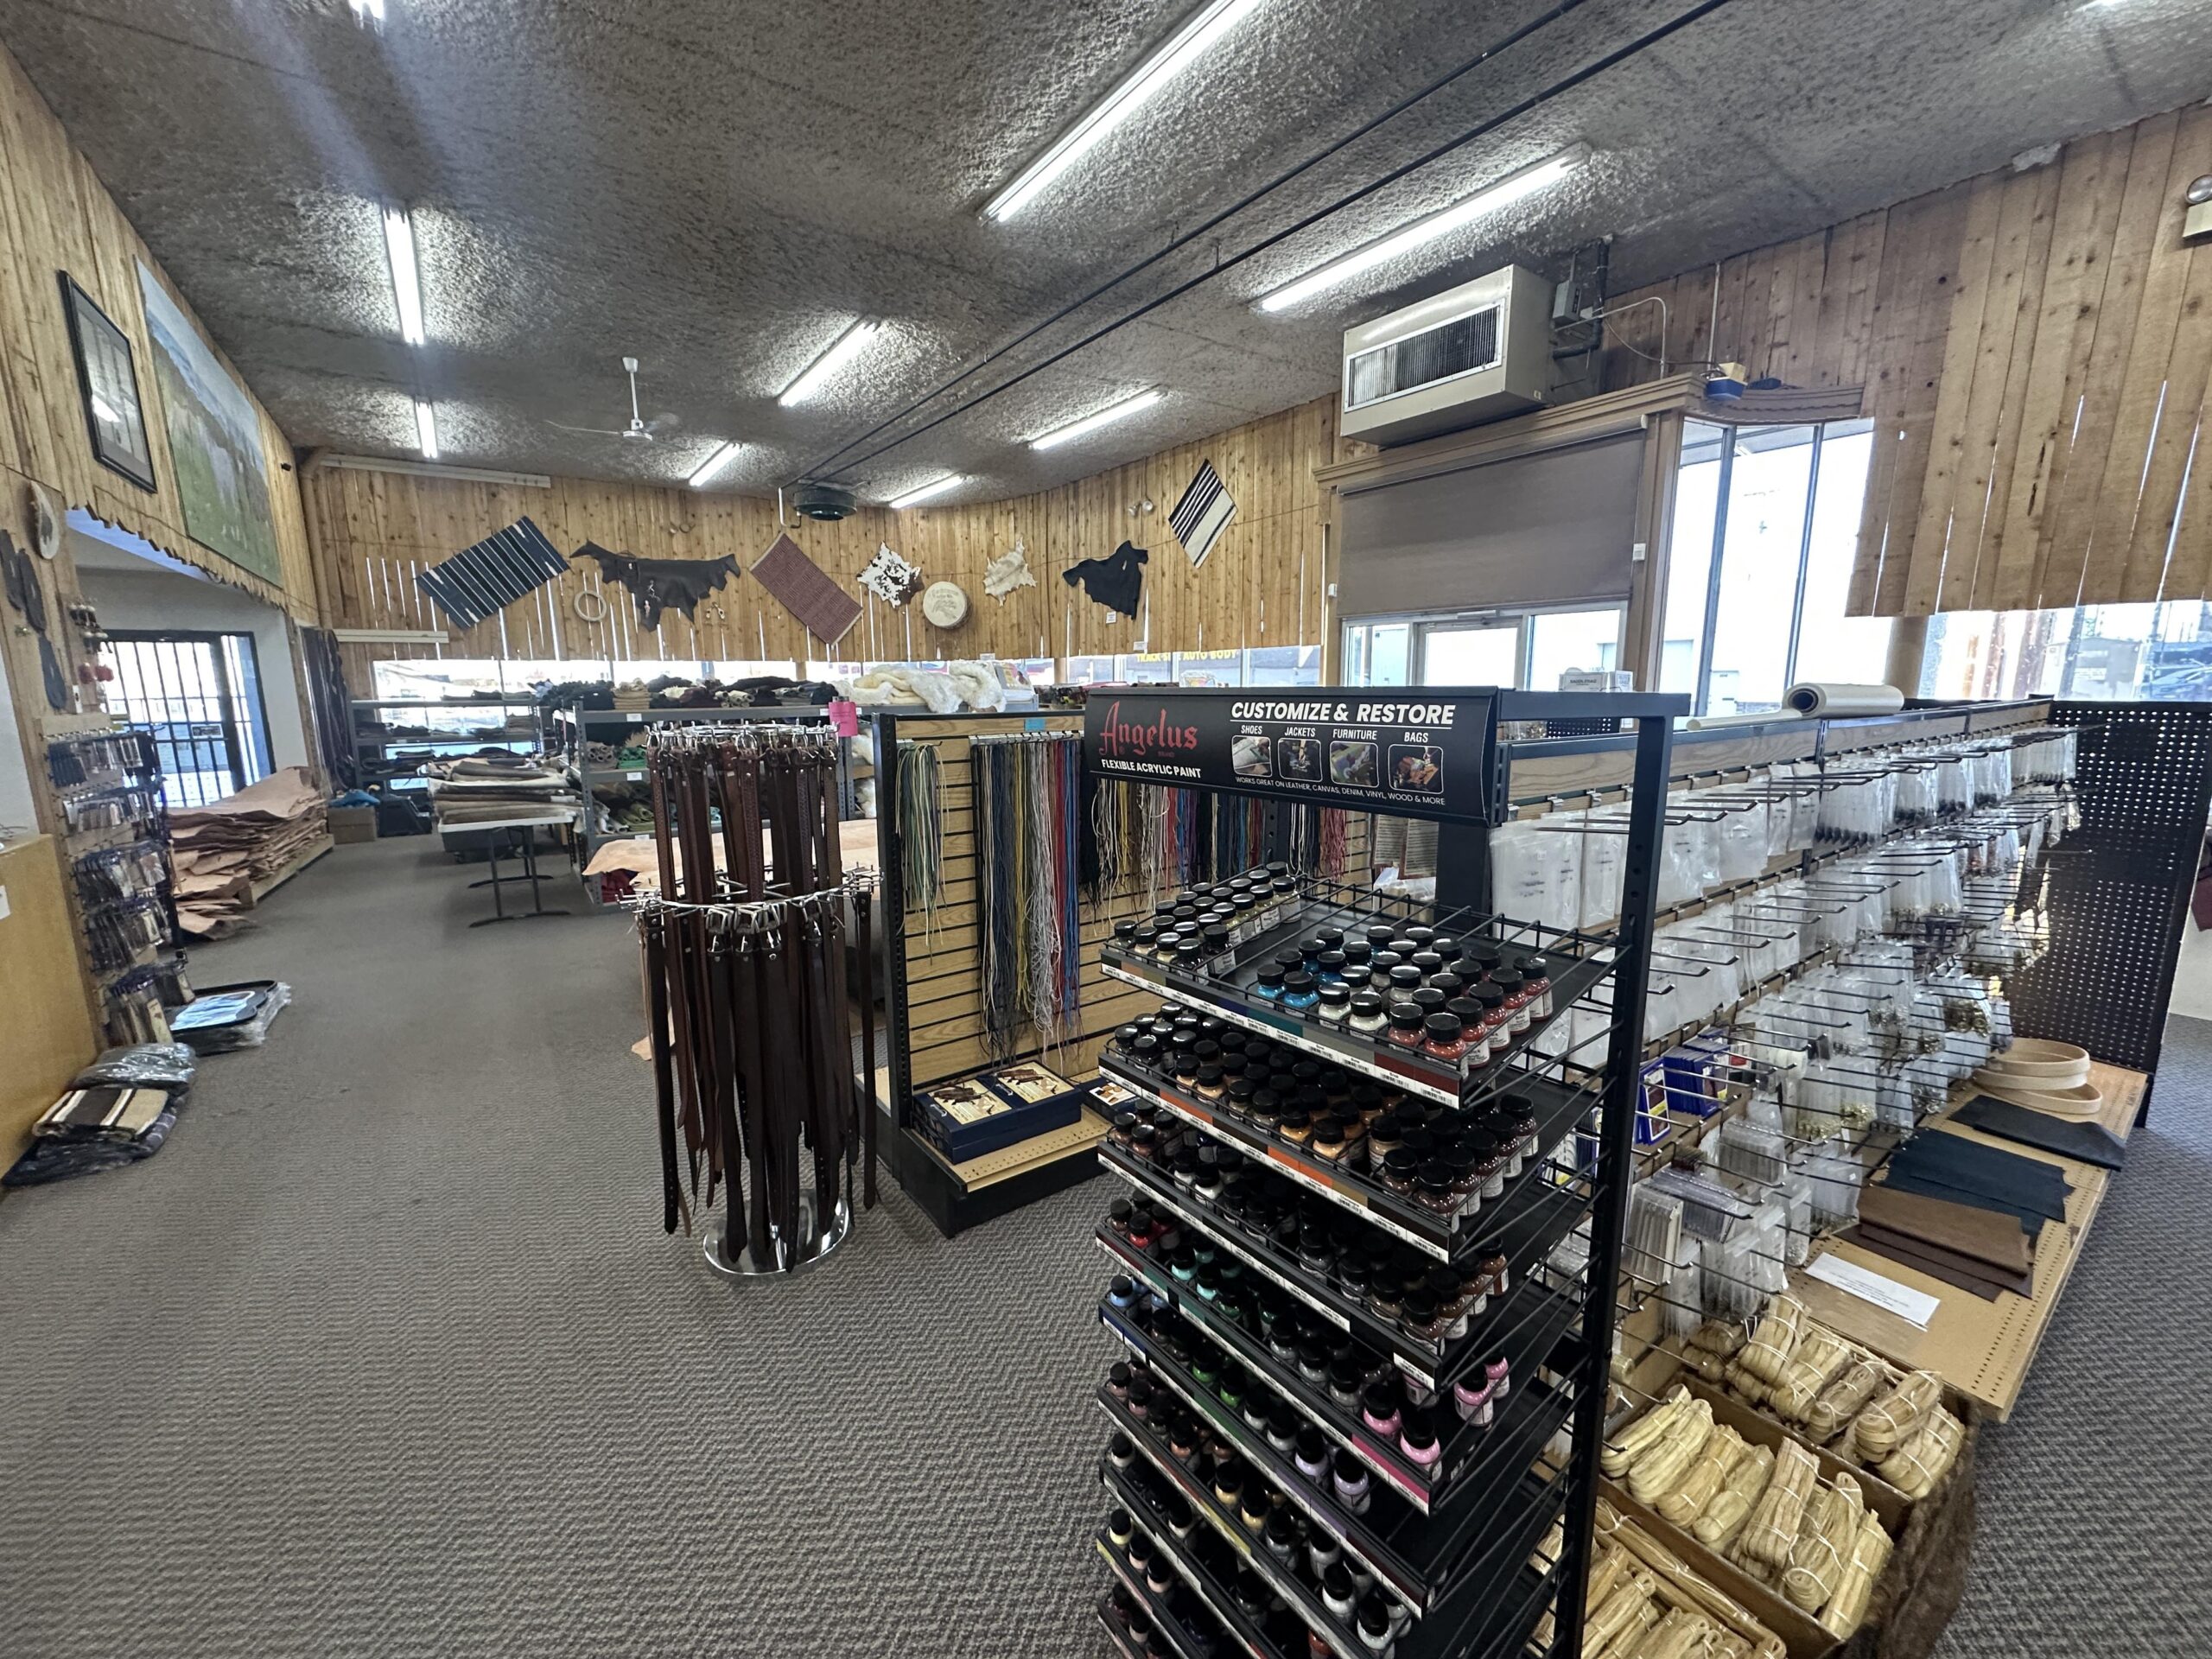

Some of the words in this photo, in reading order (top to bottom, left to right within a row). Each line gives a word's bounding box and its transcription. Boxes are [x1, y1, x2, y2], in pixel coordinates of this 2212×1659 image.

[1183, 651, 1207, 661] AUTO
[1209, 650, 1236, 659] BODY
[1231, 702, 1332, 721] CUSTOMIZE
[1333, 703, 1349, 721] &
[1357, 703, 1456, 725] RESTORE
[1098, 700, 1198, 757] Angelus
[1241, 724, 1262, 734] SHOES
[1285, 727, 1316, 737] JACKETS
[1332, 728, 1377, 741] FURNITURE
[1404, 731, 1429, 743] BAGS
[1101, 759, 1136, 772] FLEXIBLE
[1136, 762, 1173, 775] ACRYLIC
[1173, 766, 1201, 779] PAINT
[1236, 776, 1255, 785] WORKS
[1313, 785, 1341, 794] CANVAS,
[1388, 792, 1414, 802] WOOD
[1422, 797, 1446, 805] MORE
